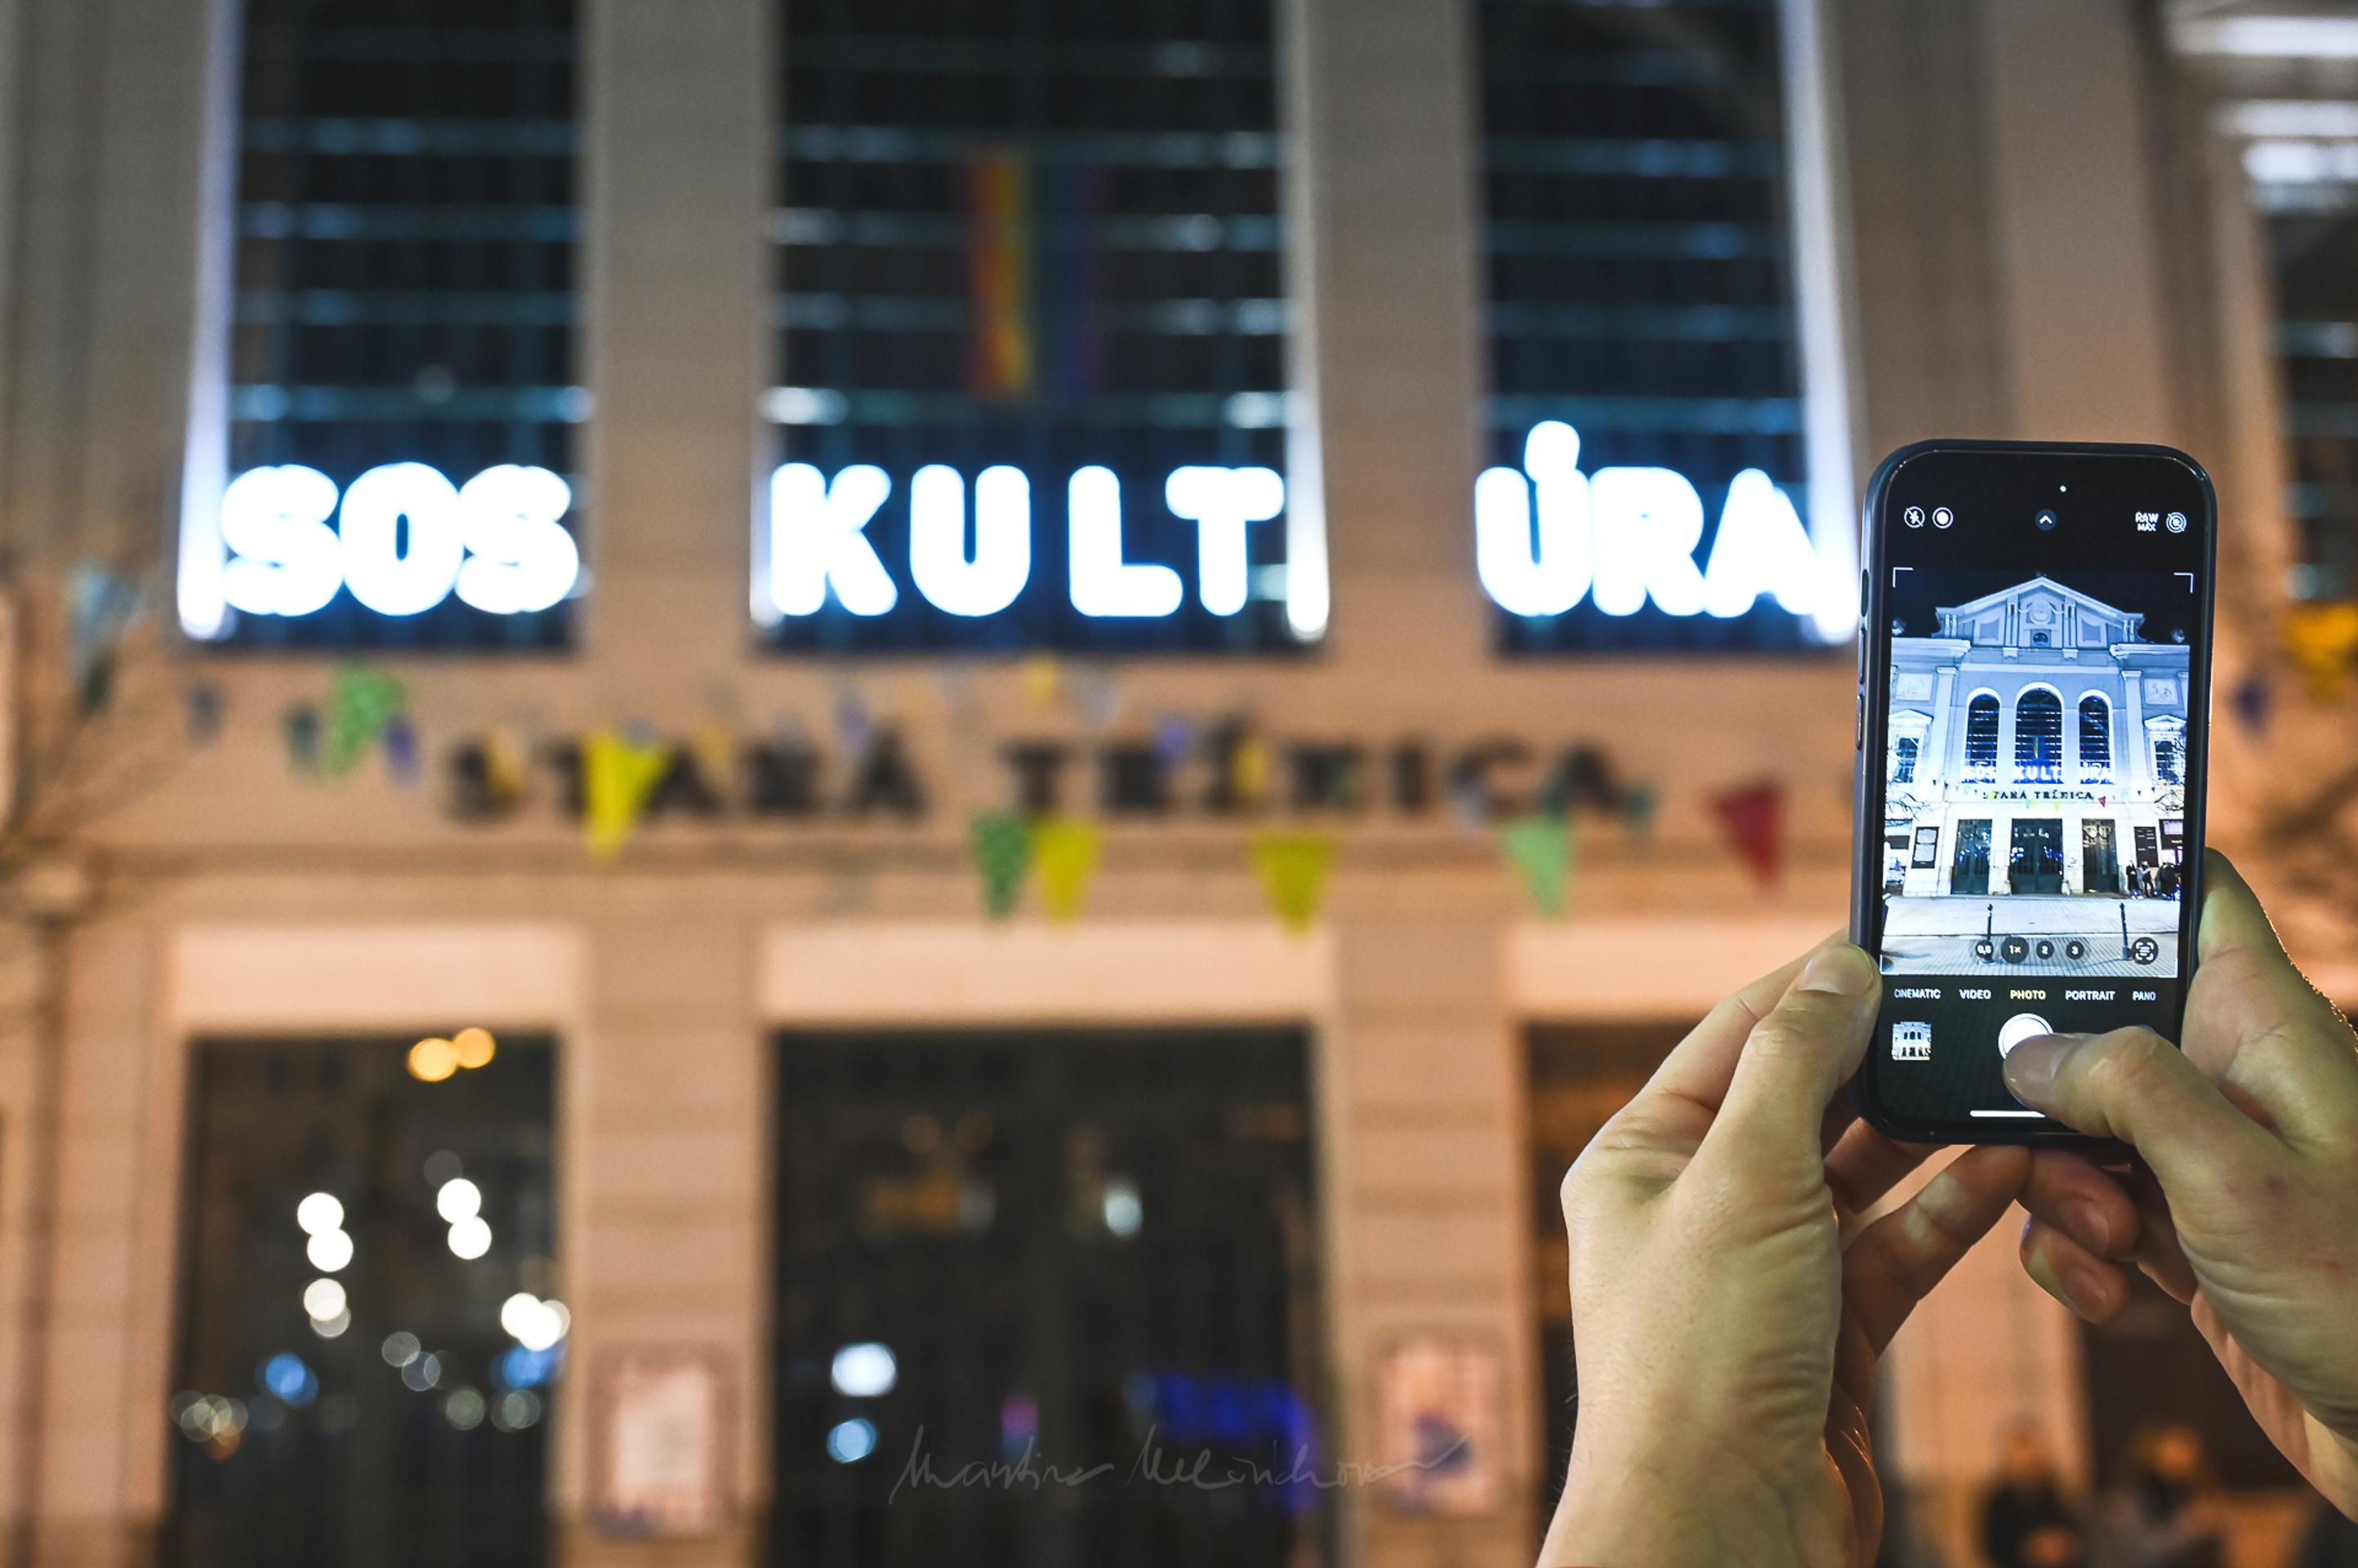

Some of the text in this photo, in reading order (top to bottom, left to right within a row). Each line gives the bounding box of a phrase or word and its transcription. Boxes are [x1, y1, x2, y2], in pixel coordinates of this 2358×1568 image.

[221, 420, 1823, 618] SOS KULT ÚRA
[2135, 511, 2159, 523] RAW
[2137, 523, 2156, 532] MAX
[1962, 765, 1996, 780] SOS
[2041, 946, 2048, 955] 2
[2071, 946, 2079, 956] 3
[1894, 988, 2156, 1001] CINEMATIC VIDEO PHOTO PORTRAIT PANO
